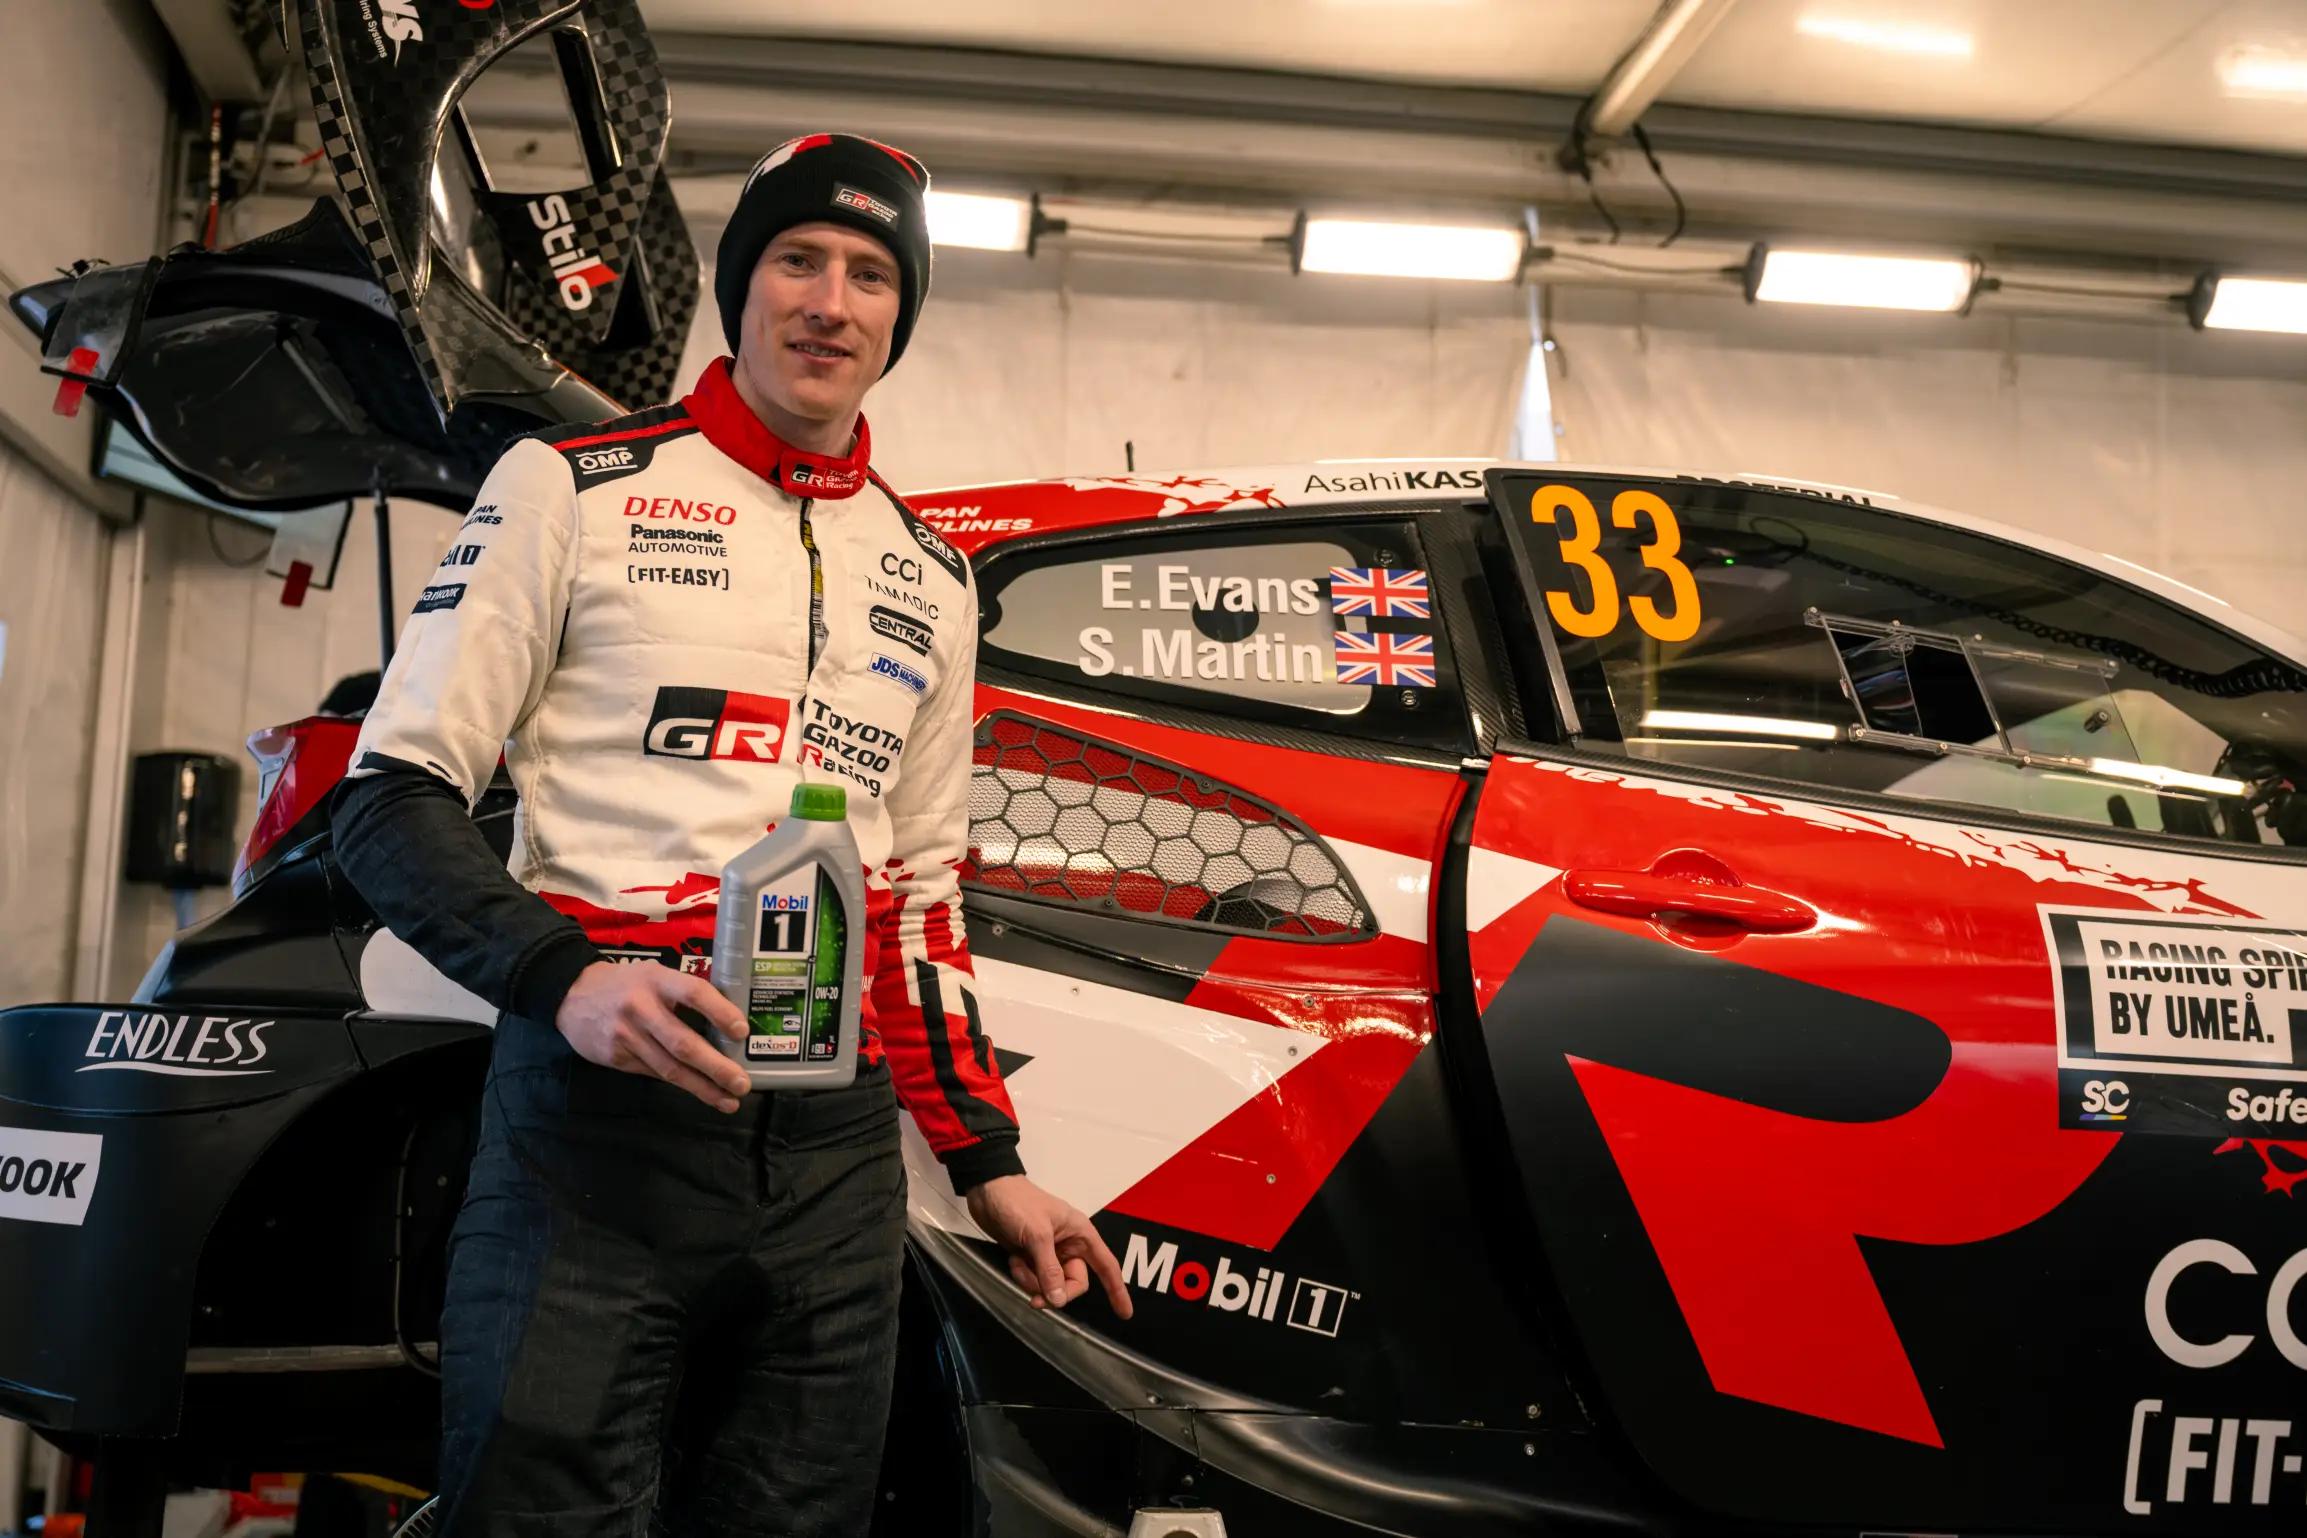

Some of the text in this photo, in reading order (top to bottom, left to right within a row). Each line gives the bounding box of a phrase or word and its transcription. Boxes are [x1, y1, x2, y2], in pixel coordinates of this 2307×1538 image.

[367, 17, 388, 58] Systems
[839, 194, 867, 208] GR
[526, 195, 602, 311] Stilo
[577, 451, 634, 470] OMP
[791, 471, 825, 487] GR
[826, 482, 854, 490] Racing
[623, 496, 737, 526] DENSO
[628, 542, 728, 557] AUTOMOTIVE
[631, 523, 724, 544] Panasonic
[880, 552, 922, 586] CCi
[1531, 484, 1702, 642] 33
[869, 612, 932, 650] CENTRAL
[871, 656, 900, 678] JDS
[648, 717, 781, 760] GR
[812, 698, 904, 757] TOYOTA
[803, 722, 890, 773] GAZOO
[796, 743, 882, 798] Racing
[762, 895, 808, 910] Mobil
[774, 913, 790, 950] 1
[755, 961, 772, 972] ESP
[2100, 939, 2232, 987] RACING
[815, 987, 839, 1000] 0W-20
[2109, 991, 2274, 1043] BY UMEÅ.
[85, 1012, 275, 1064] ENDLESS
[2081, 1080, 2130, 1114] SC
[0, 1155, 86, 1198] OOK
[1122, 1233, 1285, 1322] Mobil
